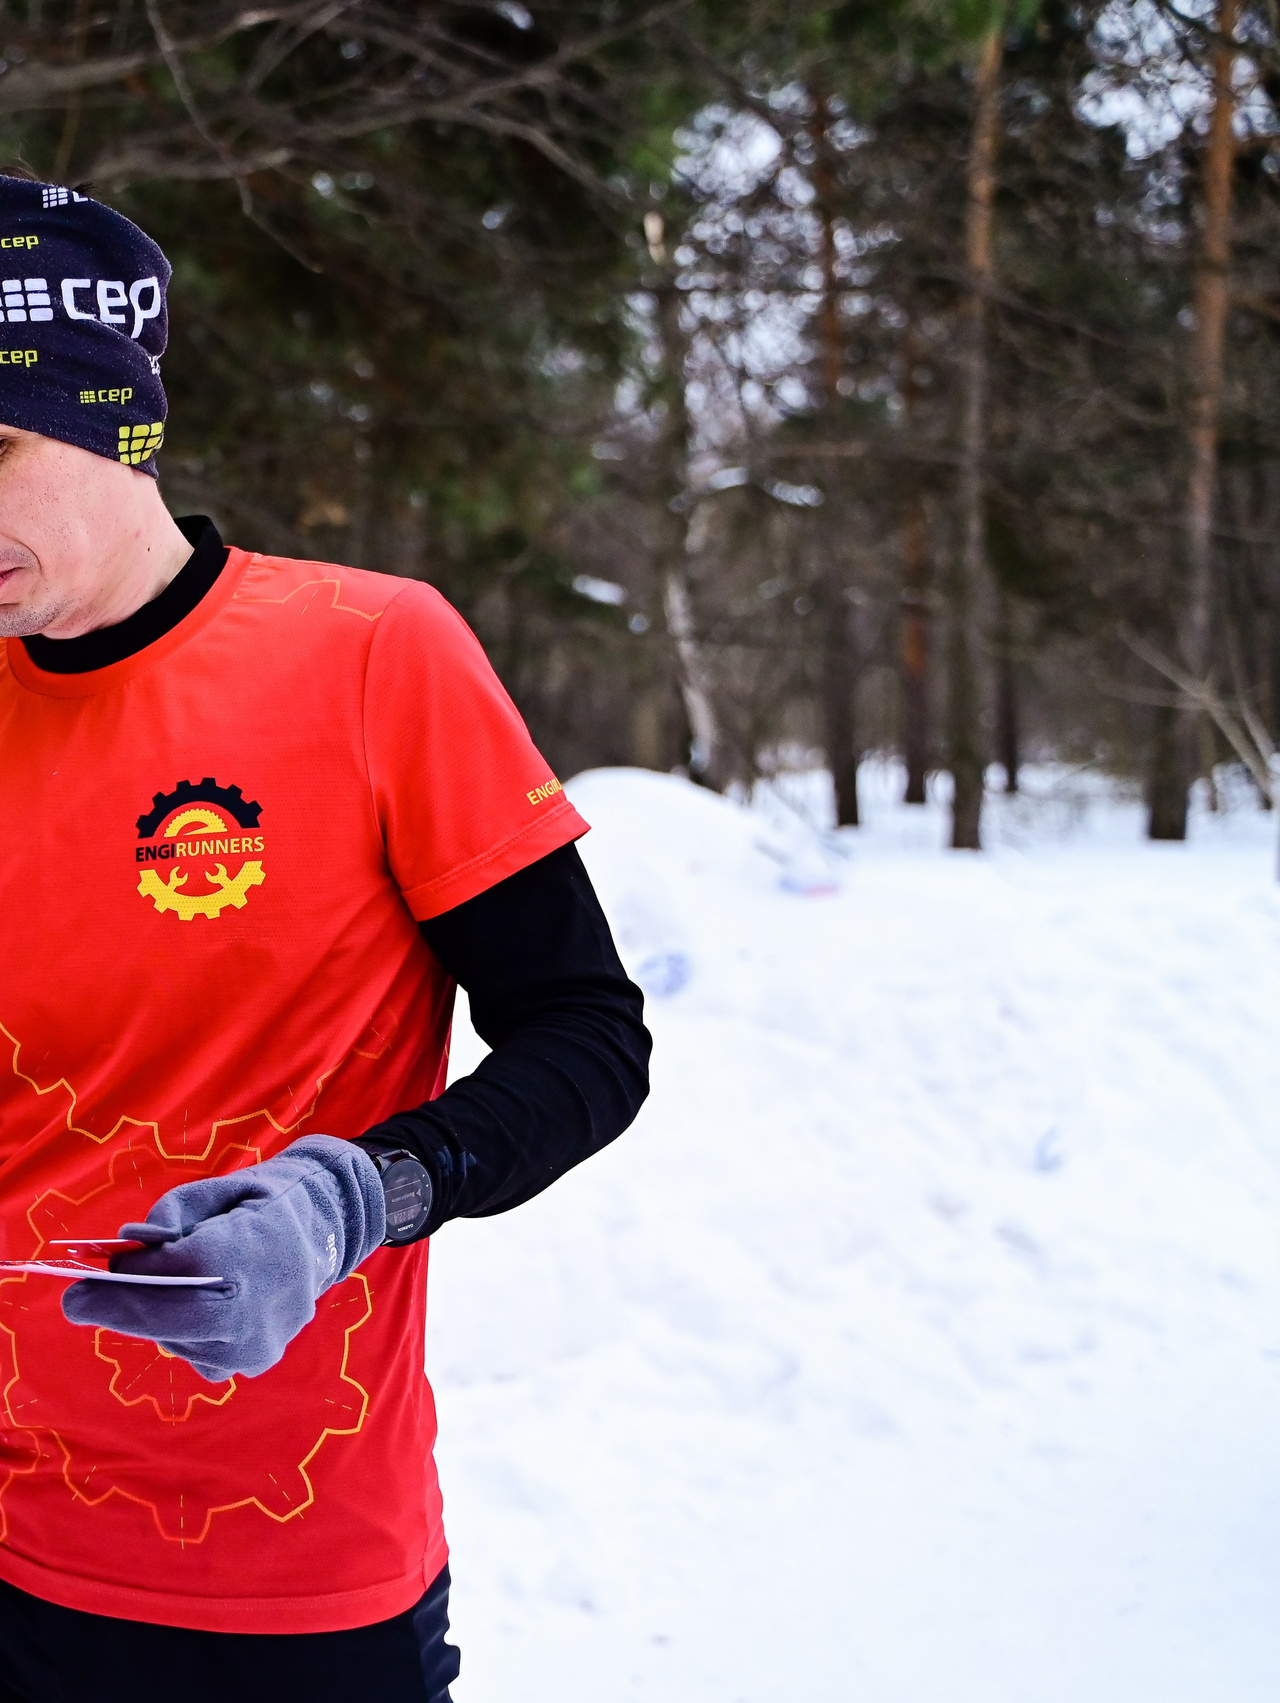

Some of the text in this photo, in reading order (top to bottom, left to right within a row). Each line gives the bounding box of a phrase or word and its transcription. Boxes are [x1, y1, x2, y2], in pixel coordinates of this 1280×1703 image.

[1, 235, 39, 249] cep
[61, 276, 161, 338] cep
[98, 387, 133, 405] cep
[135, 836, 265, 862] ENGIRUNNERS
